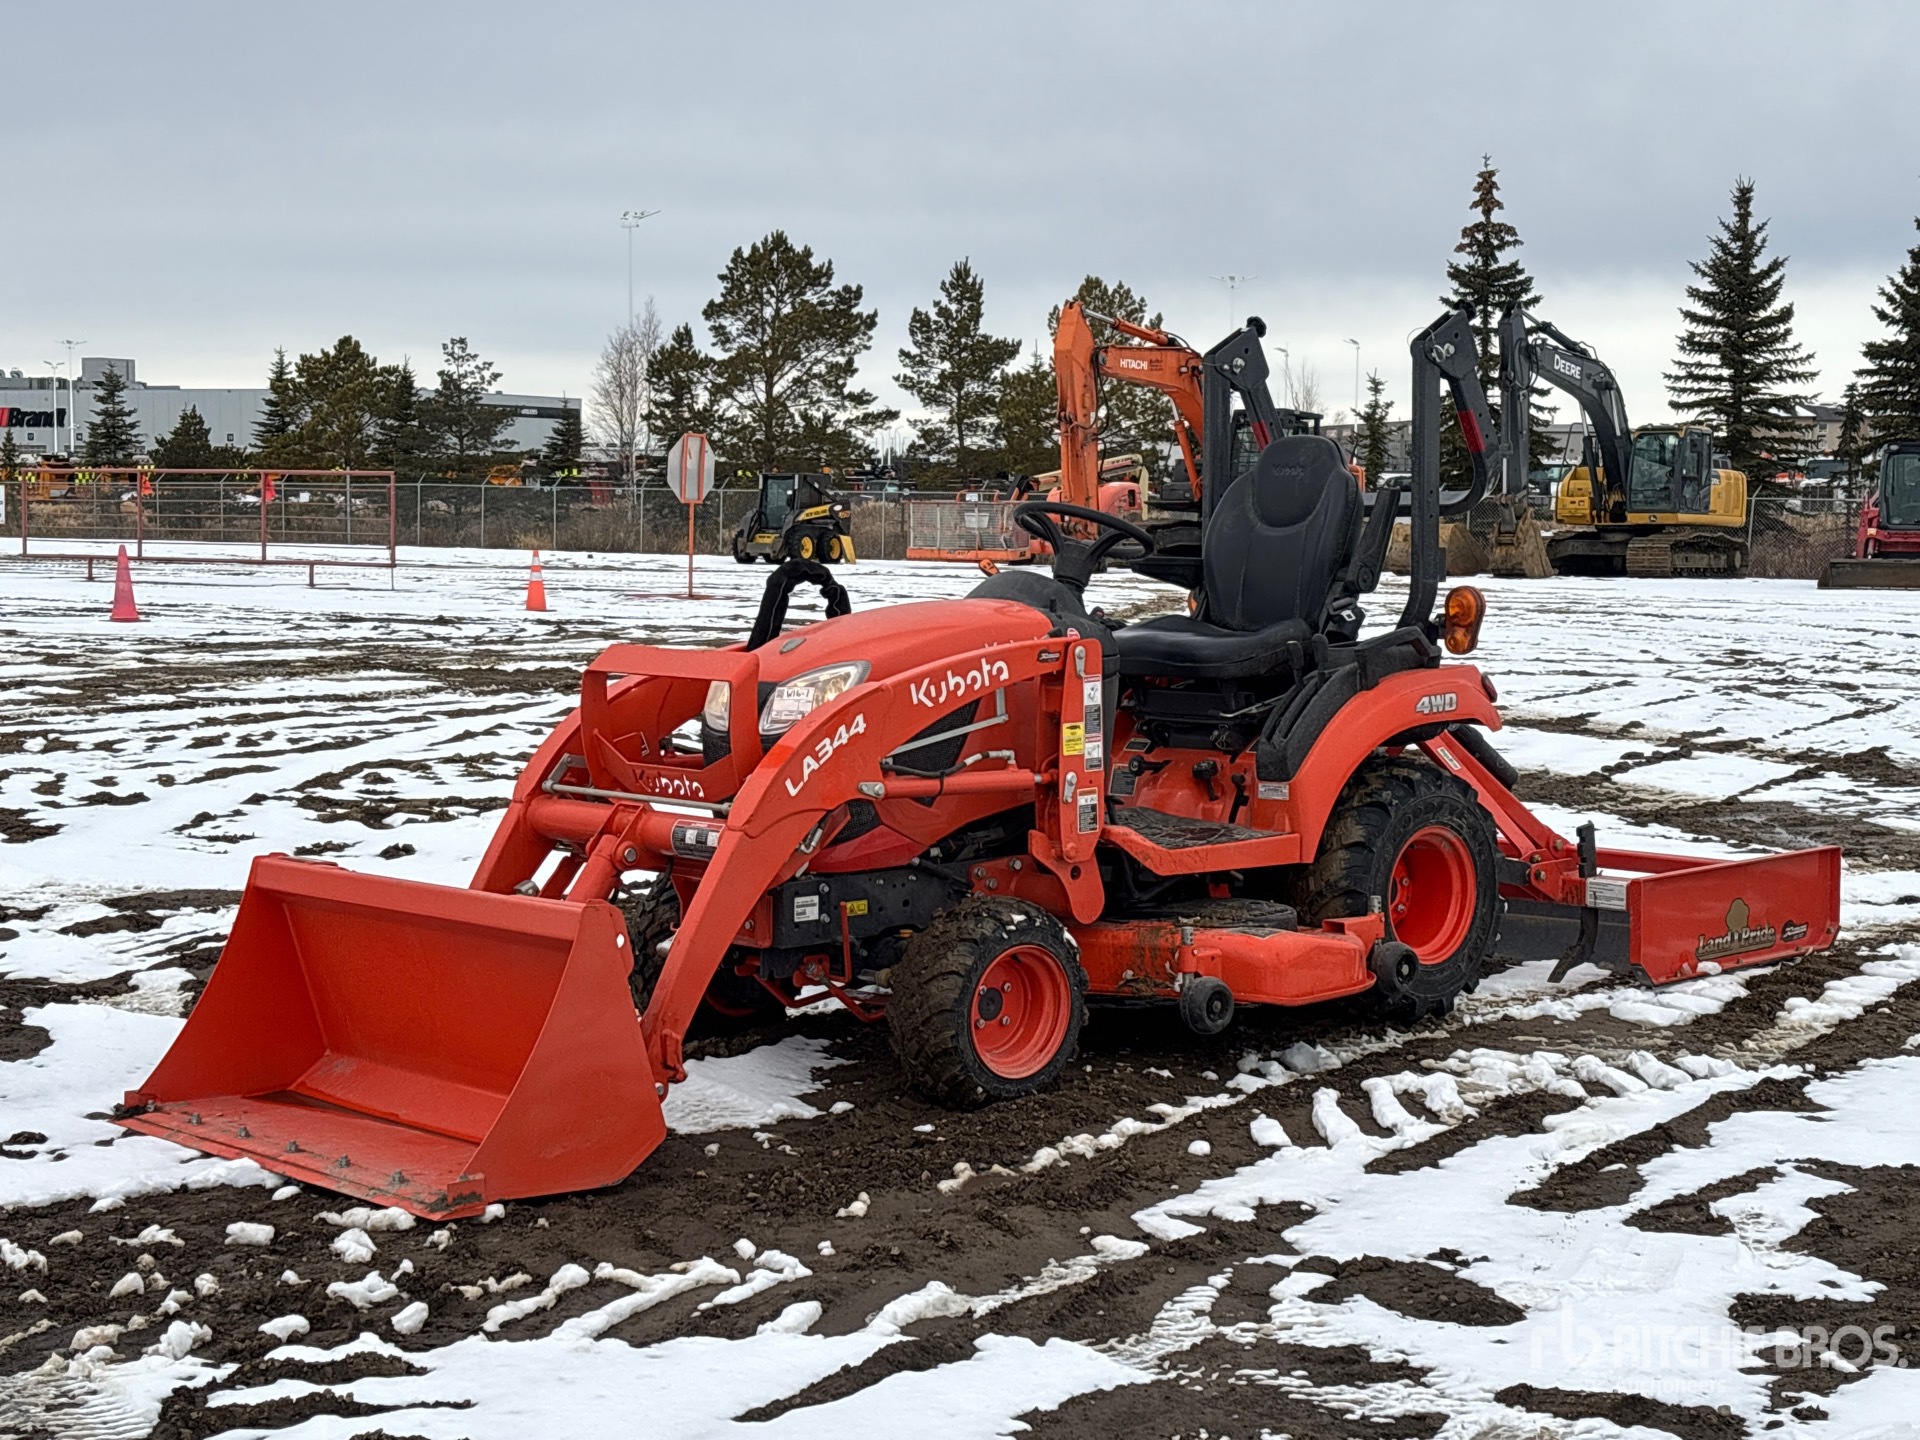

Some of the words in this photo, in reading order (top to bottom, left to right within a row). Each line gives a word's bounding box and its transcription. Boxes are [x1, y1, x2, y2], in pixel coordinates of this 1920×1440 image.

[1120, 358, 1148, 371] HITACHI
[1554, 353, 1582, 380] DEERE
[9, 407, 67, 428] Brandt
[910, 657, 1009, 708] Kubota
[1415, 692, 1458, 715] 4WD
[784, 712, 867, 797] LA344
[631, 768, 705, 799] Kubota
[1698, 930, 1732, 953] Land
[1741, 923, 1776, 946] Pride
